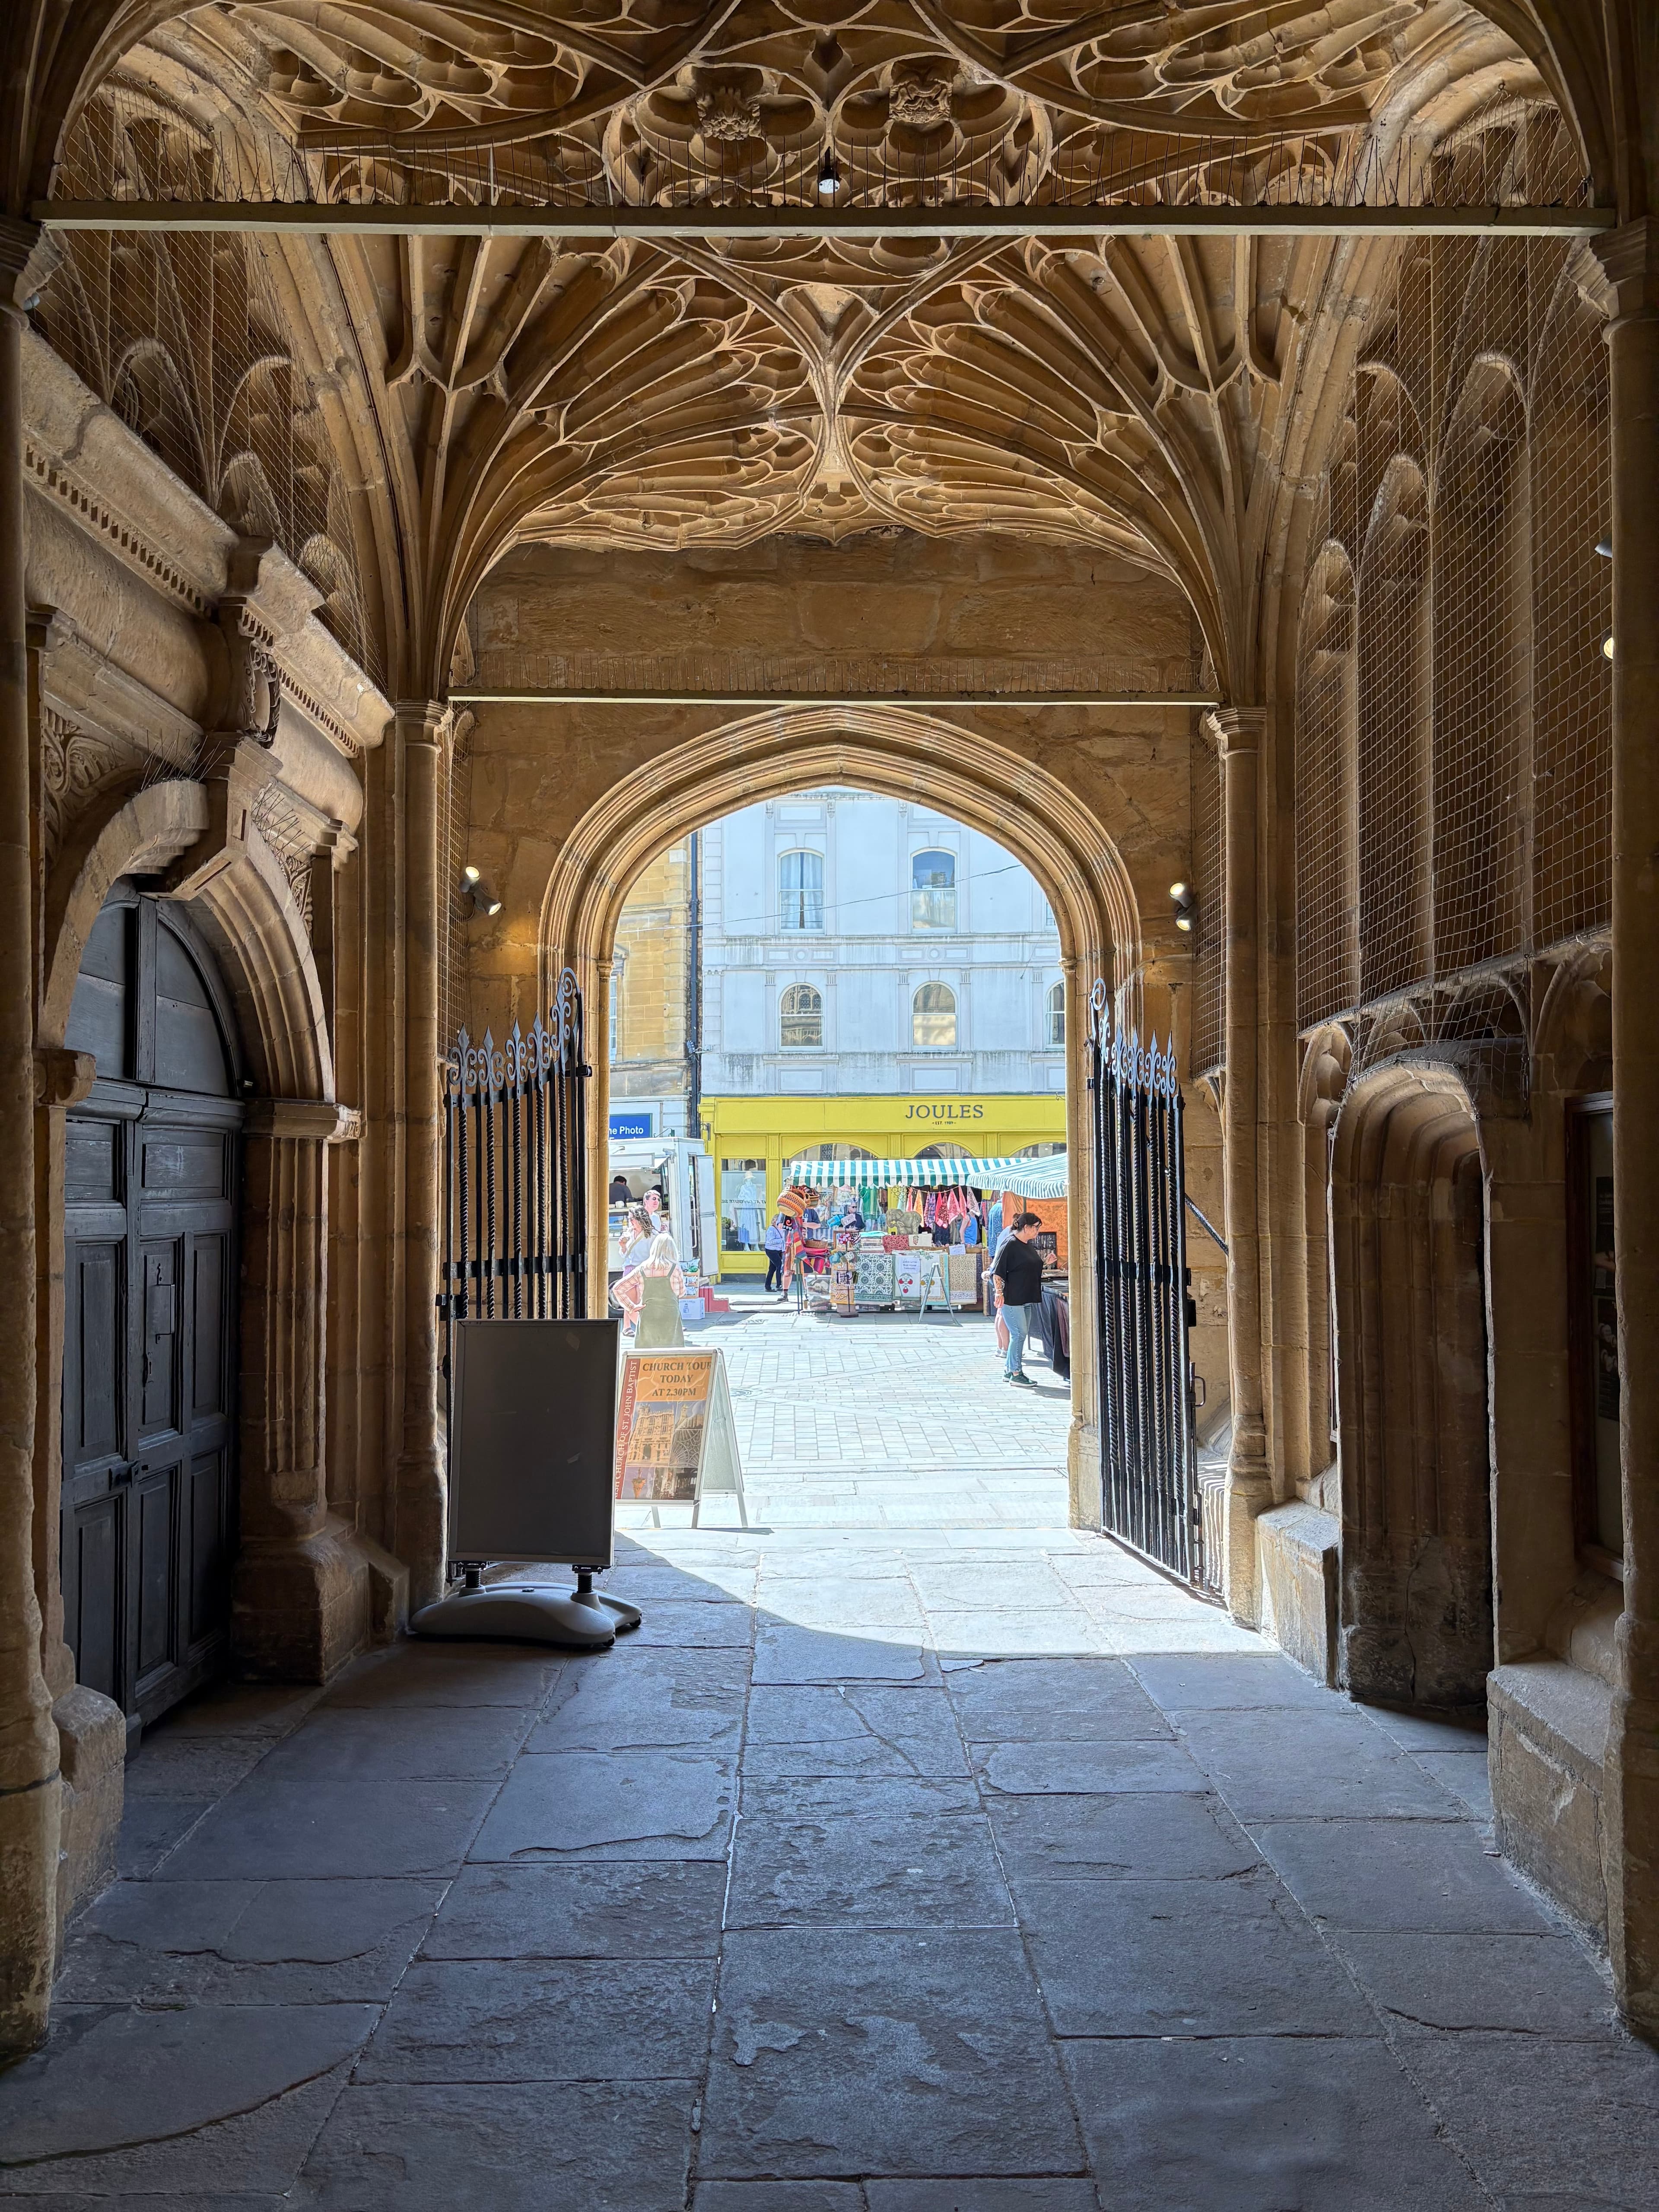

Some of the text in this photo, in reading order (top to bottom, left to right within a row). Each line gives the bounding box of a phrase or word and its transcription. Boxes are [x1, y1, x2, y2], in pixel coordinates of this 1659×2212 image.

[906, 1105, 983, 1119] JOULES
[619, 1126, 644, 1135] Photo
[642, 1362, 683, 1371] CHURCH
[626, 1361, 637, 1393] BAPTIST
[660, 1375, 693, 1383] TODAY
[666, 1388, 696, 1396] 2.30PM
[624, 1396, 632, 1417] JOHN
[619, 1431, 627, 1443] OF
[615, 1444, 625, 1479] CHURCH
